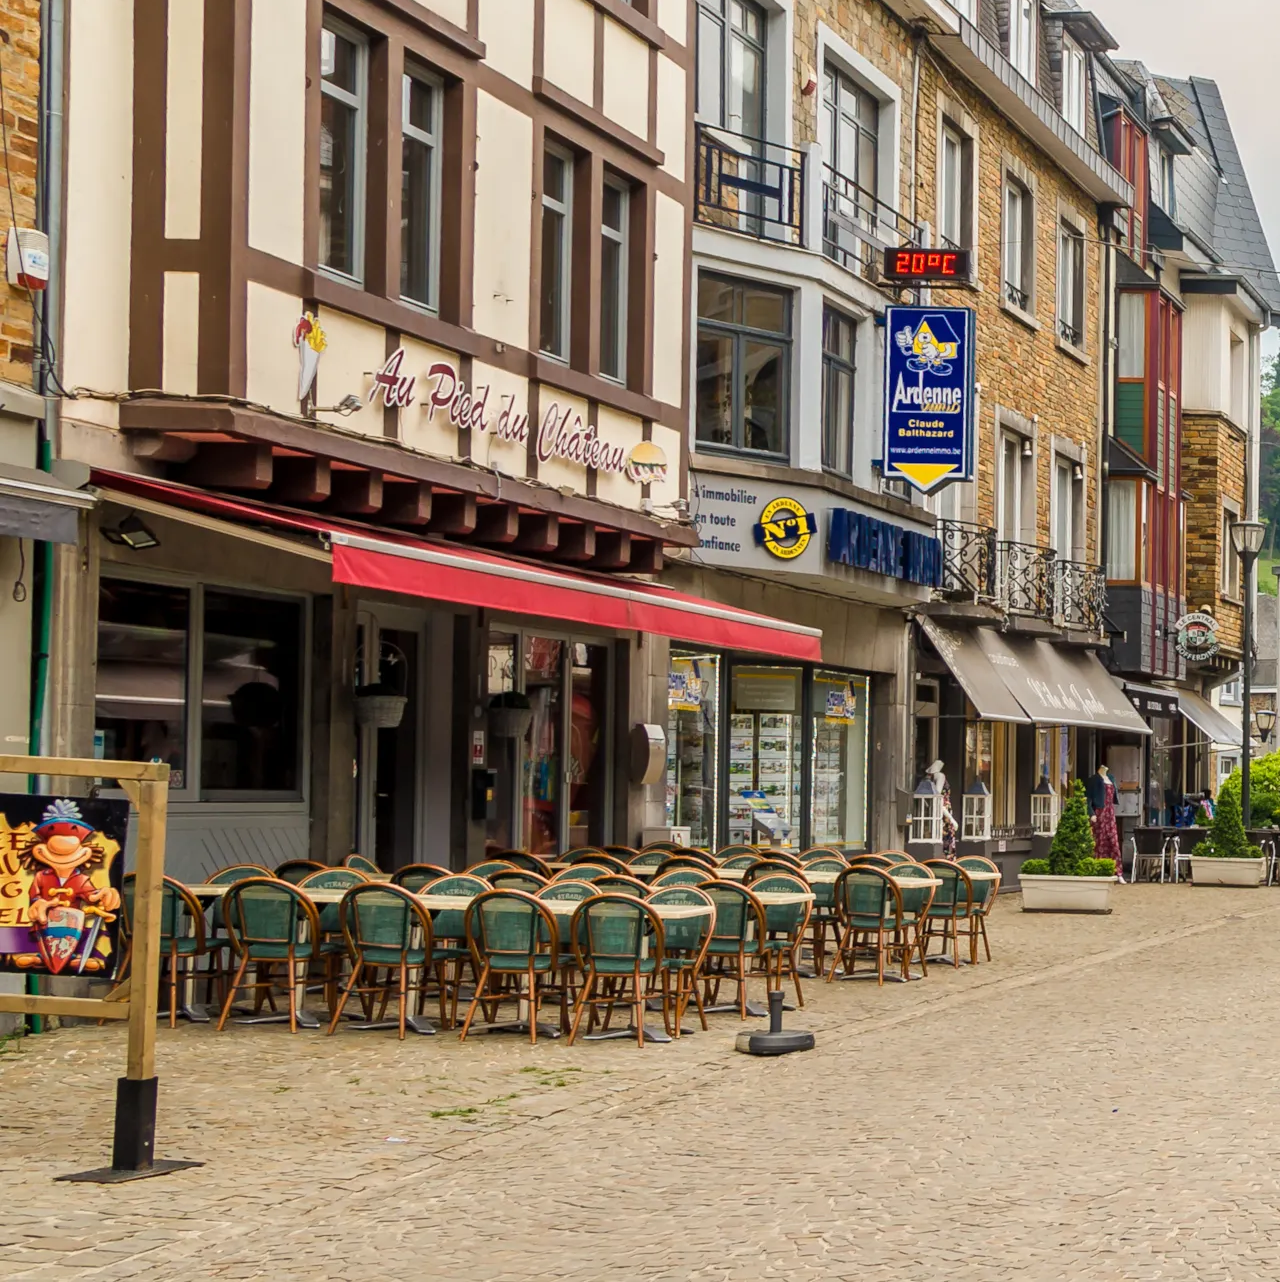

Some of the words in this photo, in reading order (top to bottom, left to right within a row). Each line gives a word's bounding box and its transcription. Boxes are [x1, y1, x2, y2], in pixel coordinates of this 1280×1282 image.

[892, 370, 962, 412] Ardenne
[368, 346, 416, 407] Au
[427, 362, 490, 431] Pied
[497, 393, 529, 442] du
[536, 402, 627, 473] Château
[908, 419, 945, 428] Claude
[898, 428, 954, 438] Balthazard
[890, 446, 961, 455] www.ardenneimmo.be
[710, 513, 736, 526] toute
[699, 536, 741, 552] onfiance
[1178, 618, 1187, 627] LE
[1188, 615, 1216, 628] CENTRAL
[1175, 644, 1219, 661] BOFFERDING
